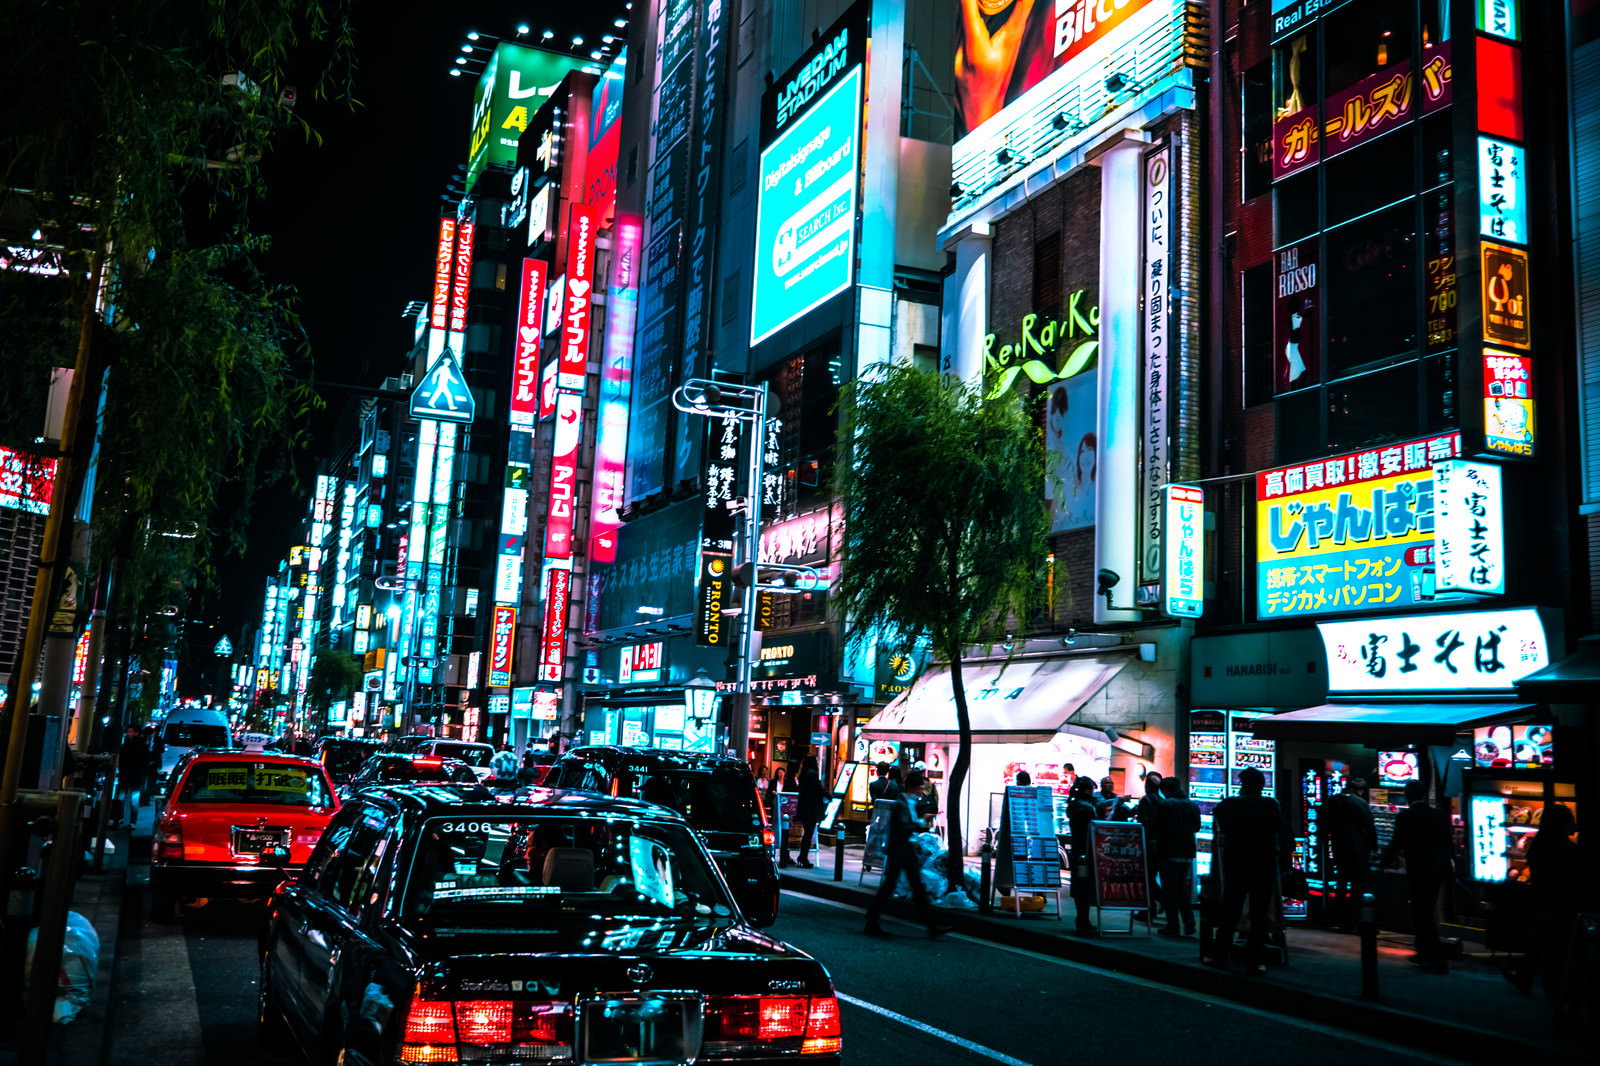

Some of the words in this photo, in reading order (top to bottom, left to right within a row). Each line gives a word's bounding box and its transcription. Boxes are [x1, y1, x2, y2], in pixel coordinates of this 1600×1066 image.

[1053, 0, 1131, 58] Bitc
[1275, 6, 1302, 33] Real
[776, 48, 847, 129] STADIUM
[1488, 143, 1508, 237] 富士そば
[797, 208, 831, 243] SEARCH
[1278, 263, 1317, 299] ROSSO
[1281, 247, 1299, 273] BAR
[565, 295, 587, 363] アイフル
[516, 342, 537, 402] アイフル
[551, 465, 573, 518] アコム
[1464, 491, 1496, 586] 富士そば
[708, 580, 722, 644] PRONTO
[1266, 583, 1402, 613] デジカメ・パソコン
[494, 610, 512, 668] ナポリタン
[760, 645, 794, 660] PRONTO
[1360, 625, 1508, 678] 富士そば
[628, 765, 648, 773] 3441
[442, 822, 492, 833] 3406
